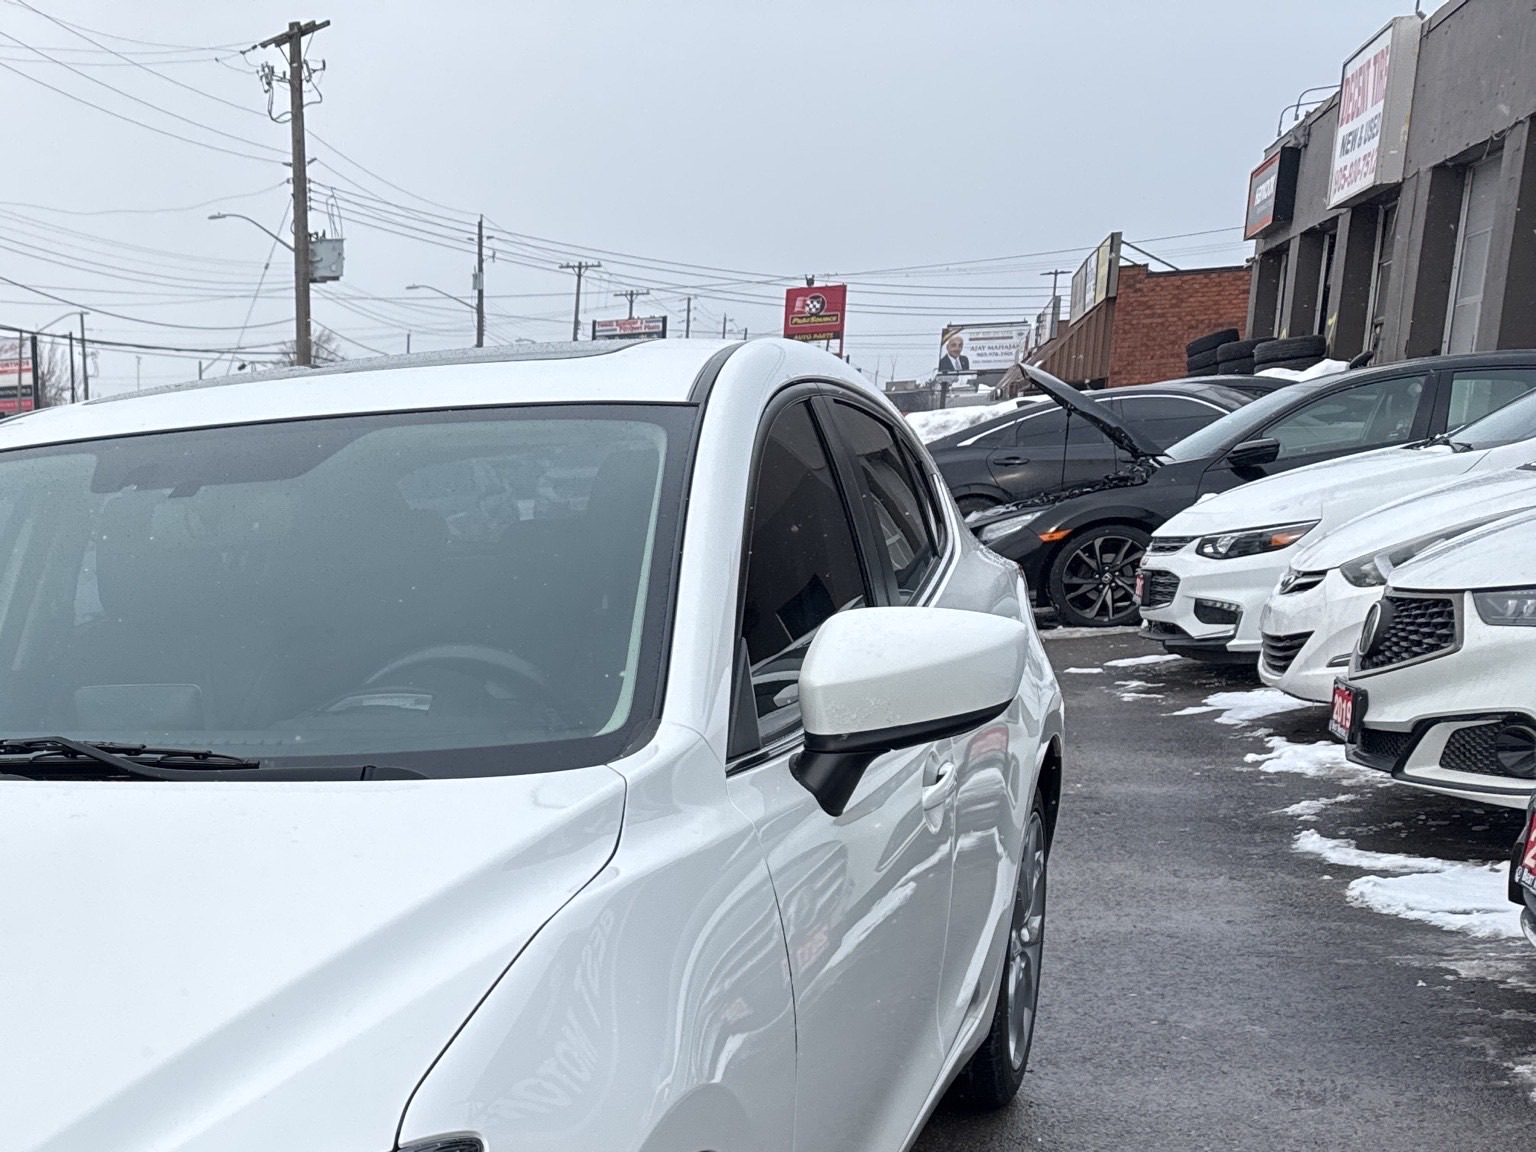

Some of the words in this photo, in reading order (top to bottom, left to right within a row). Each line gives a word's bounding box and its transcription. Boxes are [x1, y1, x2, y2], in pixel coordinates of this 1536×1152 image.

[1339, 127, 1360, 158] NEW
[812, 332, 834, 340] PARTS
[970, 344, 986, 352] AJAY
[1332, 693, 1353, 729] 2019
